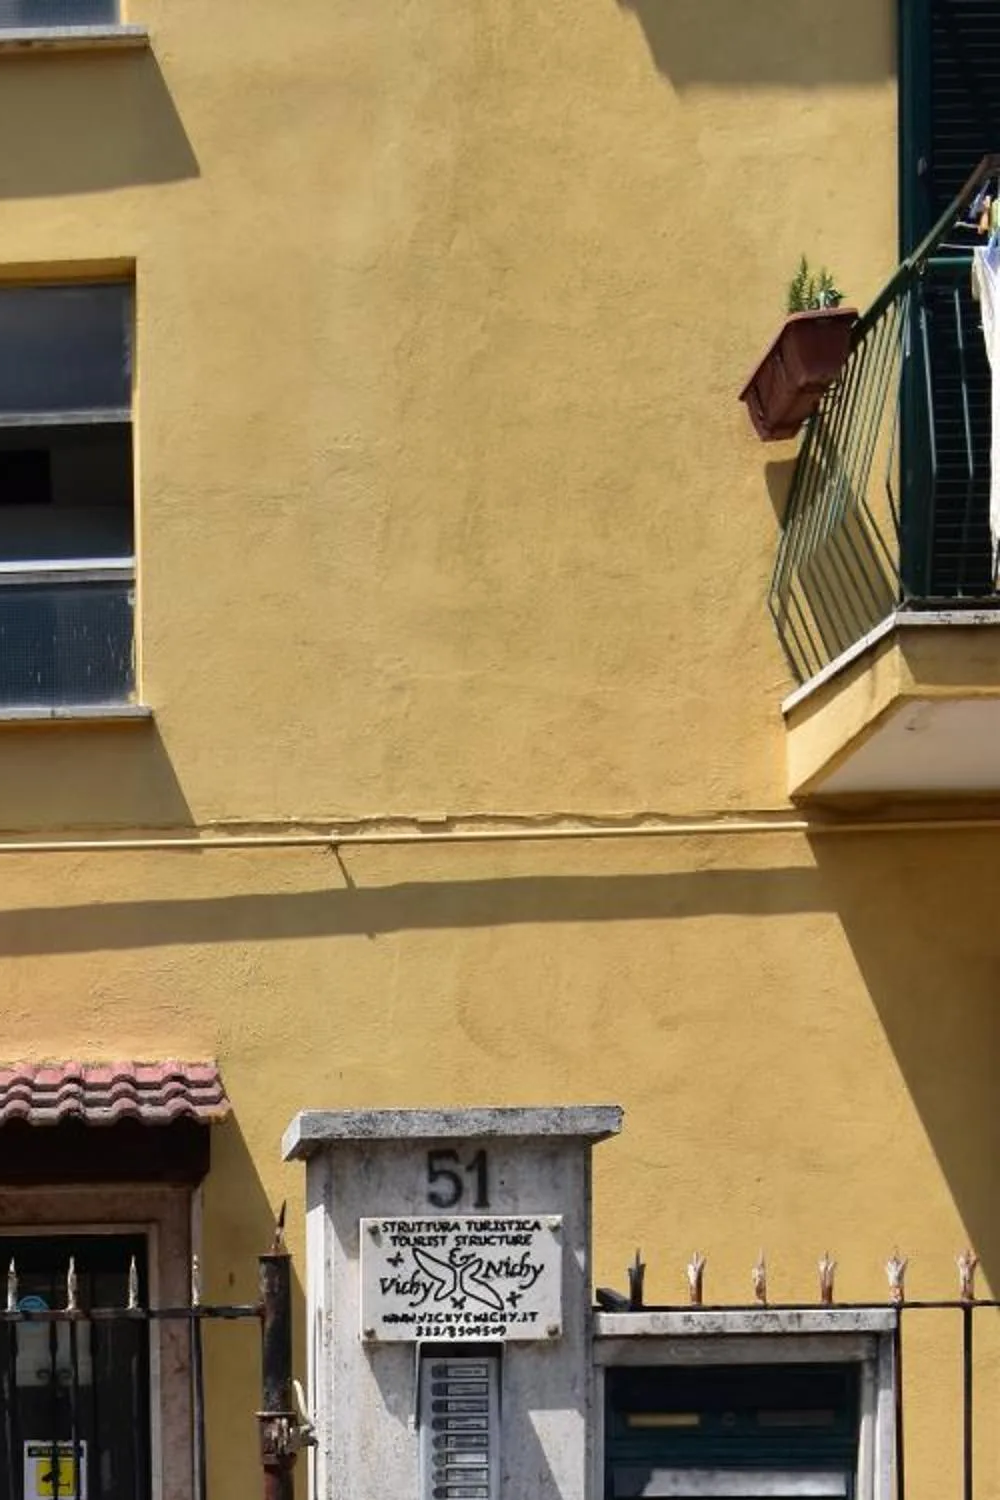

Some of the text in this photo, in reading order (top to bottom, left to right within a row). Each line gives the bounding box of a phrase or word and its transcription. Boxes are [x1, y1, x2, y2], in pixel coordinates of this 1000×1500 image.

[427, 1149, 491, 1208] 51
[381, 1219, 542, 1233] STRUTTURA TURISTICA
[391, 1234, 532, 1246] TOURIST STRUCTURE
[379, 1269, 434, 1307] Vichy
[482, 1251, 545, 1290] Nichy
